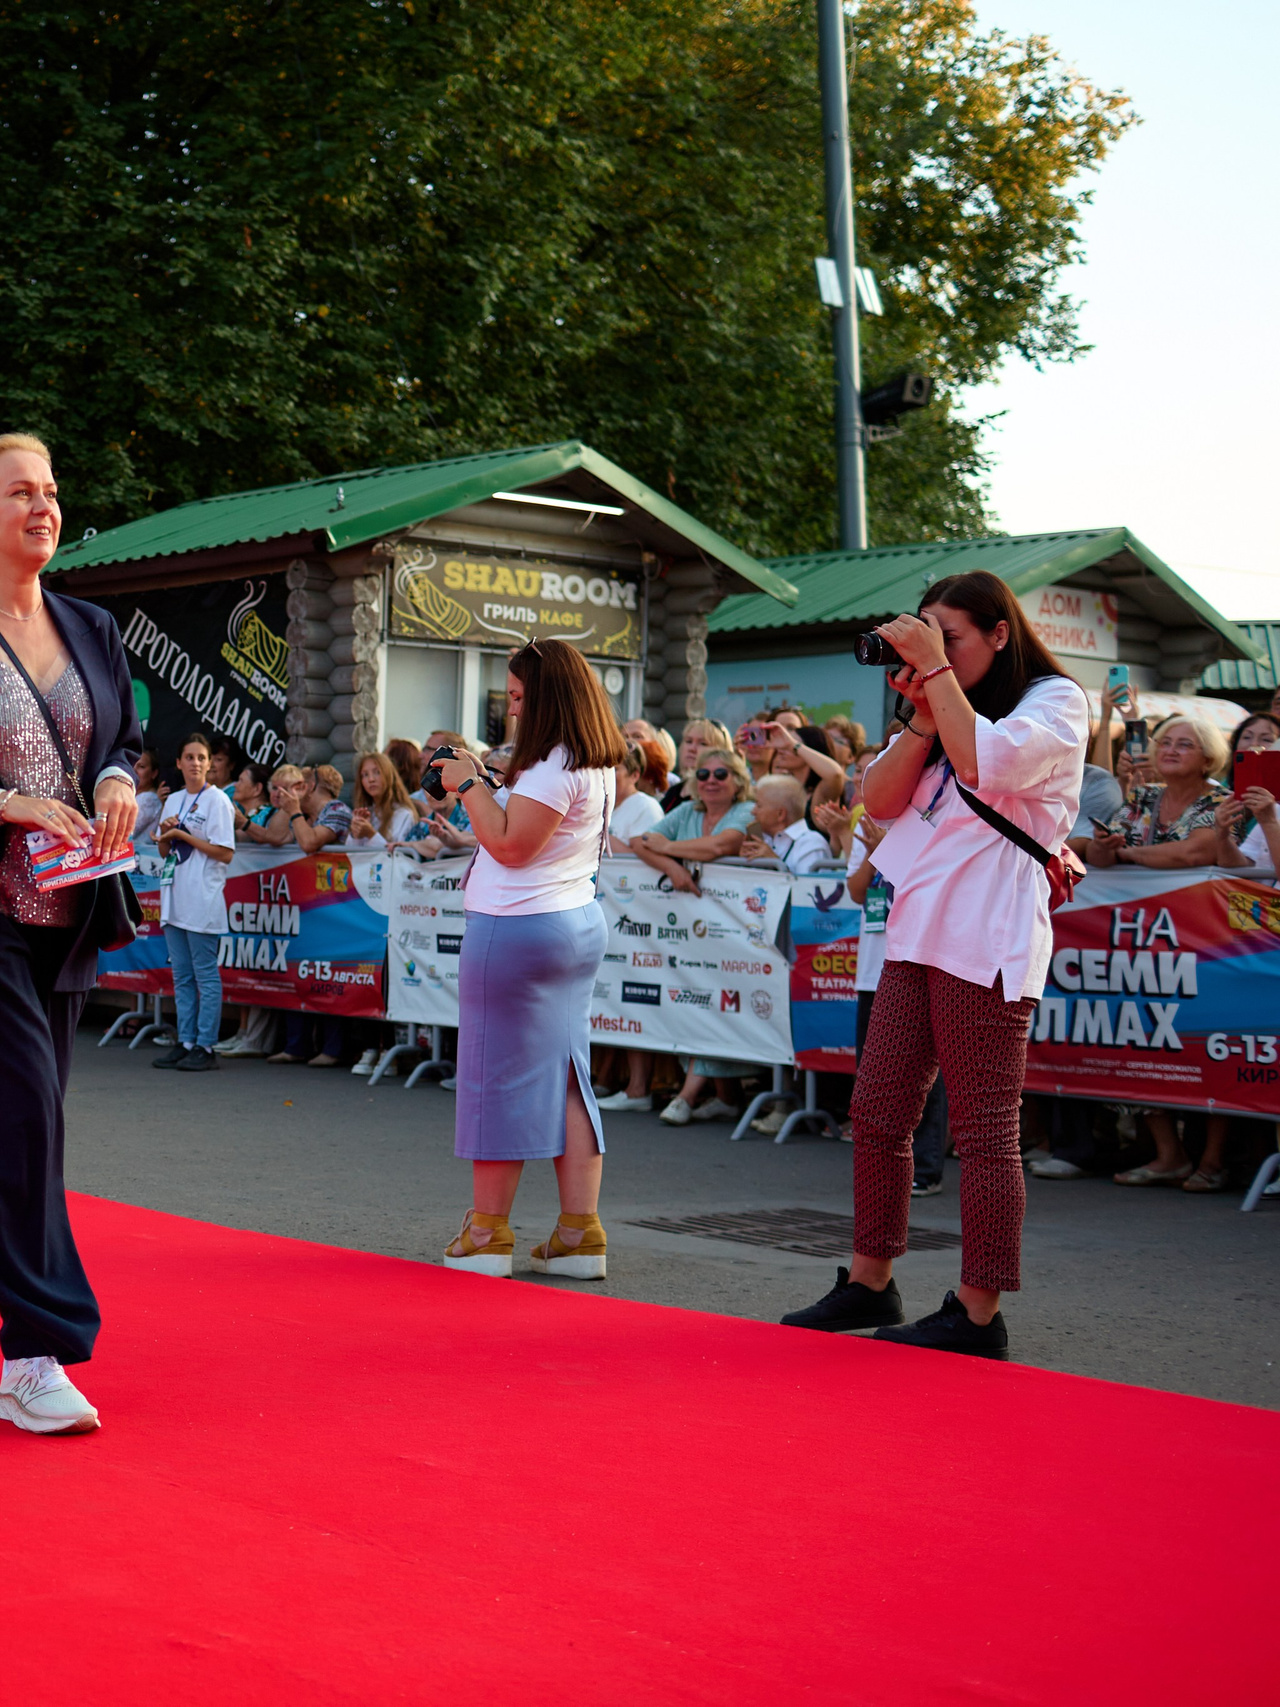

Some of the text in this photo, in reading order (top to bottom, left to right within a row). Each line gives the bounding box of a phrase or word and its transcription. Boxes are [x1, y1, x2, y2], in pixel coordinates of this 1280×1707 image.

[443, 560, 637, 610] SHAUROOM
[483, 603, 584, 629] ГРИЛЬ КАФЕ
[1038, 592, 1082, 618] ДОМ
[122, 607, 286, 768] ПРОГОЛОДАЛСЯ?
[221, 642, 288, 711] SHAUROOM
[42, 870, 91, 889] ПРИГЛАШЕНИЕ
[260, 874, 292, 903] НА
[229, 902, 300, 936] СЕМИ
[1114, 907, 1179, 948] НА
[298, 960, 375, 986] 6-13 АВГУСТА
[811, 976, 857, 990] ТЕАТРА
[1052, 948, 1198, 996] СЕМИ
[1028, 997, 1183, 1050] ЛМАХ
[1206, 1032, 1277, 1063] 6-13
[1237, 1067, 1280, 1084] КИР
